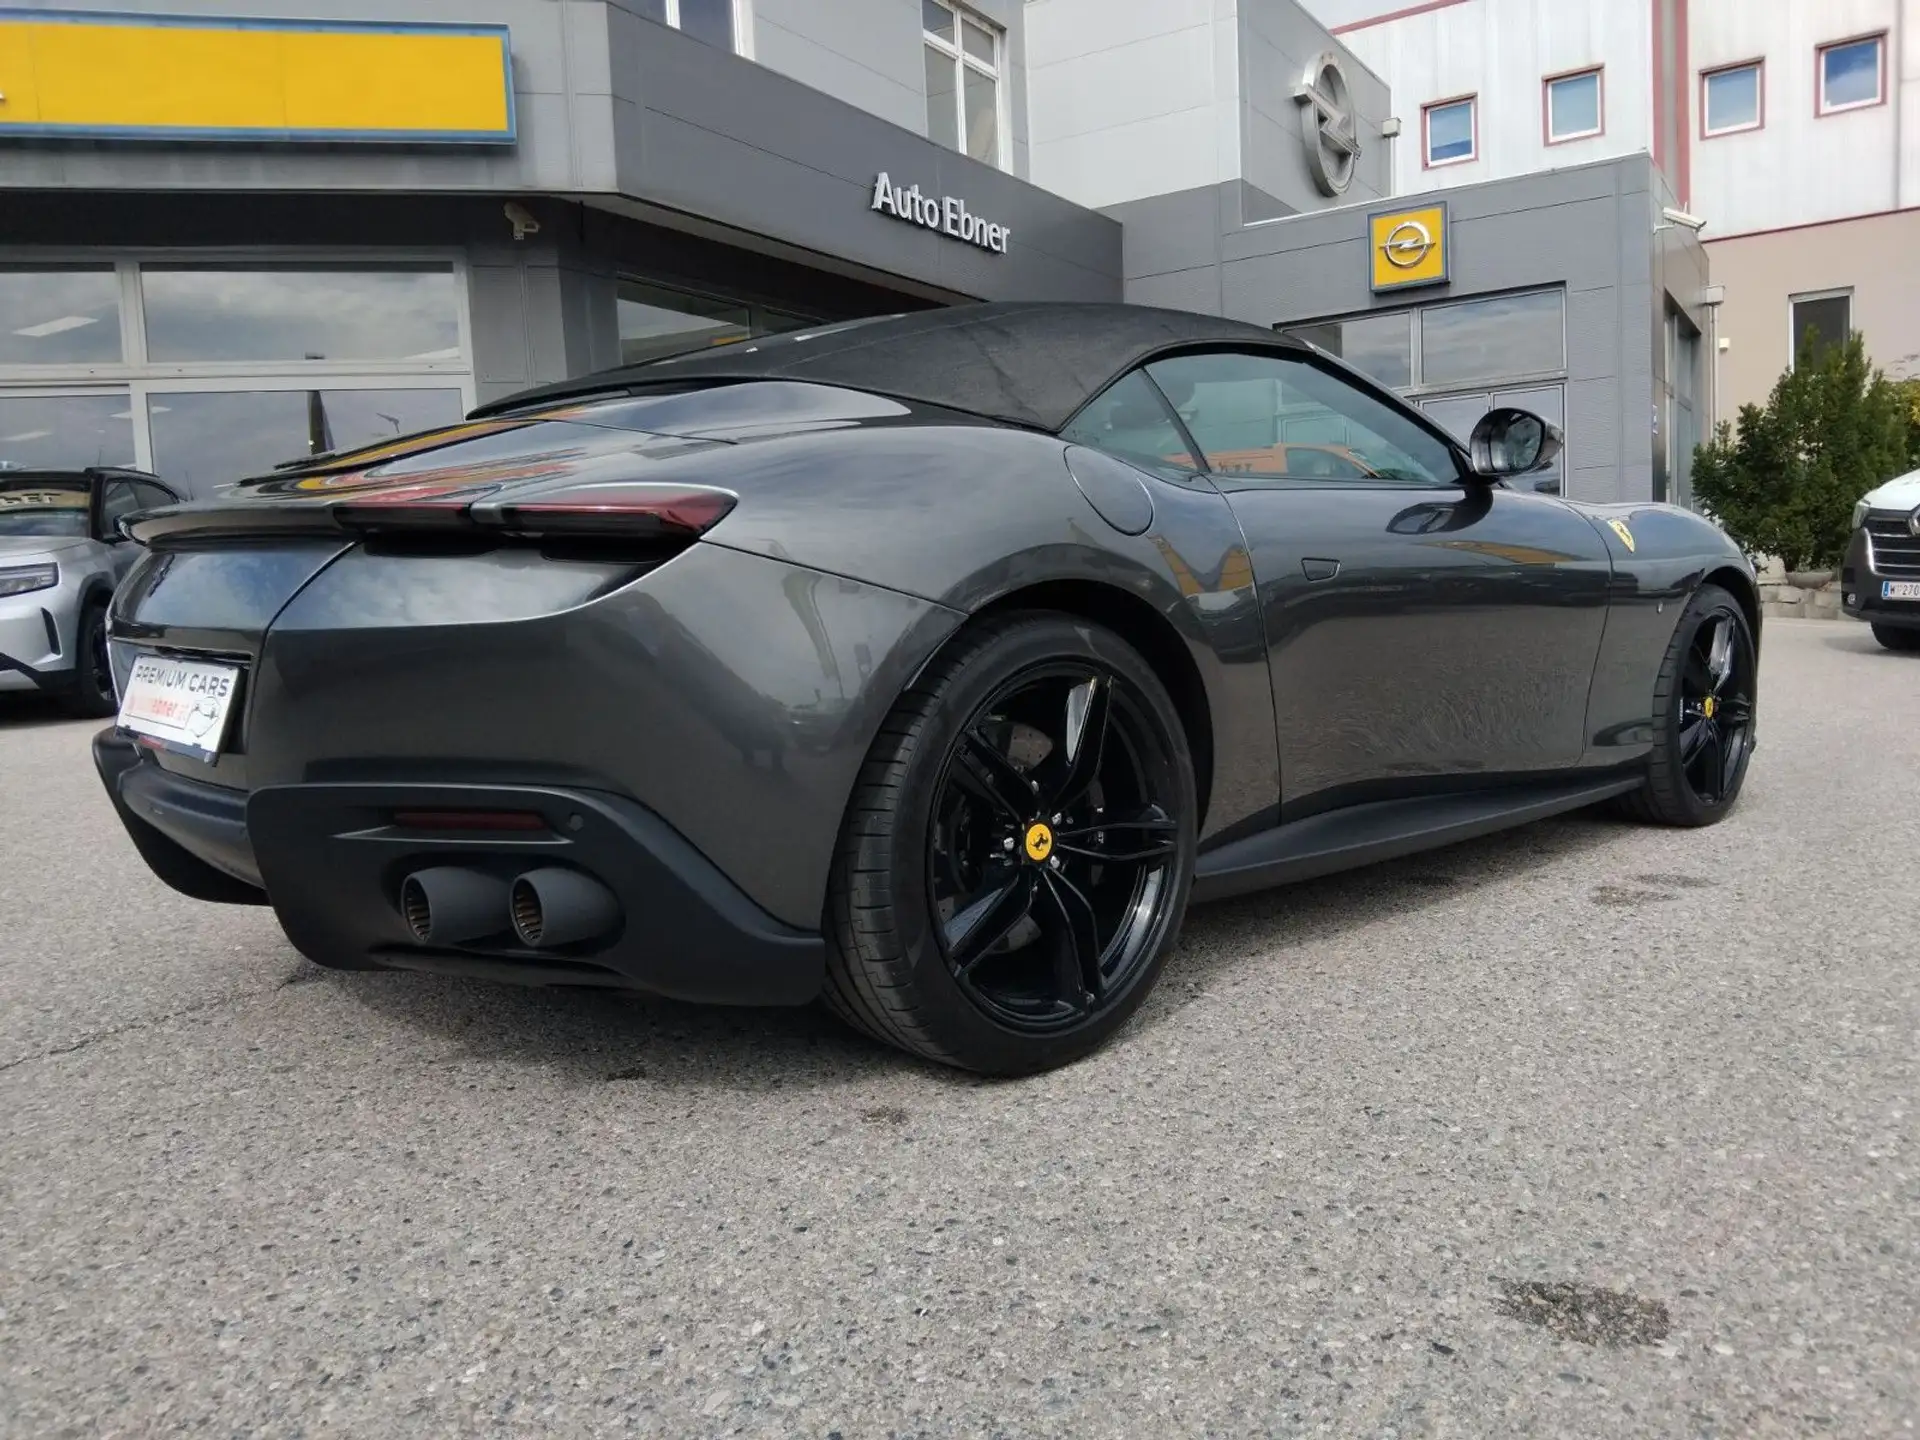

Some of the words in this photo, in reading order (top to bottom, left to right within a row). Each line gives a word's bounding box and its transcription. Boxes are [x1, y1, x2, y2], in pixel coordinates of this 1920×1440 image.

[872, 172, 940, 228] Auto
[942, 196, 1010, 254] Ebner
[136, 665, 187, 690] PREMIUM
[189, 673, 230, 697] CARS
